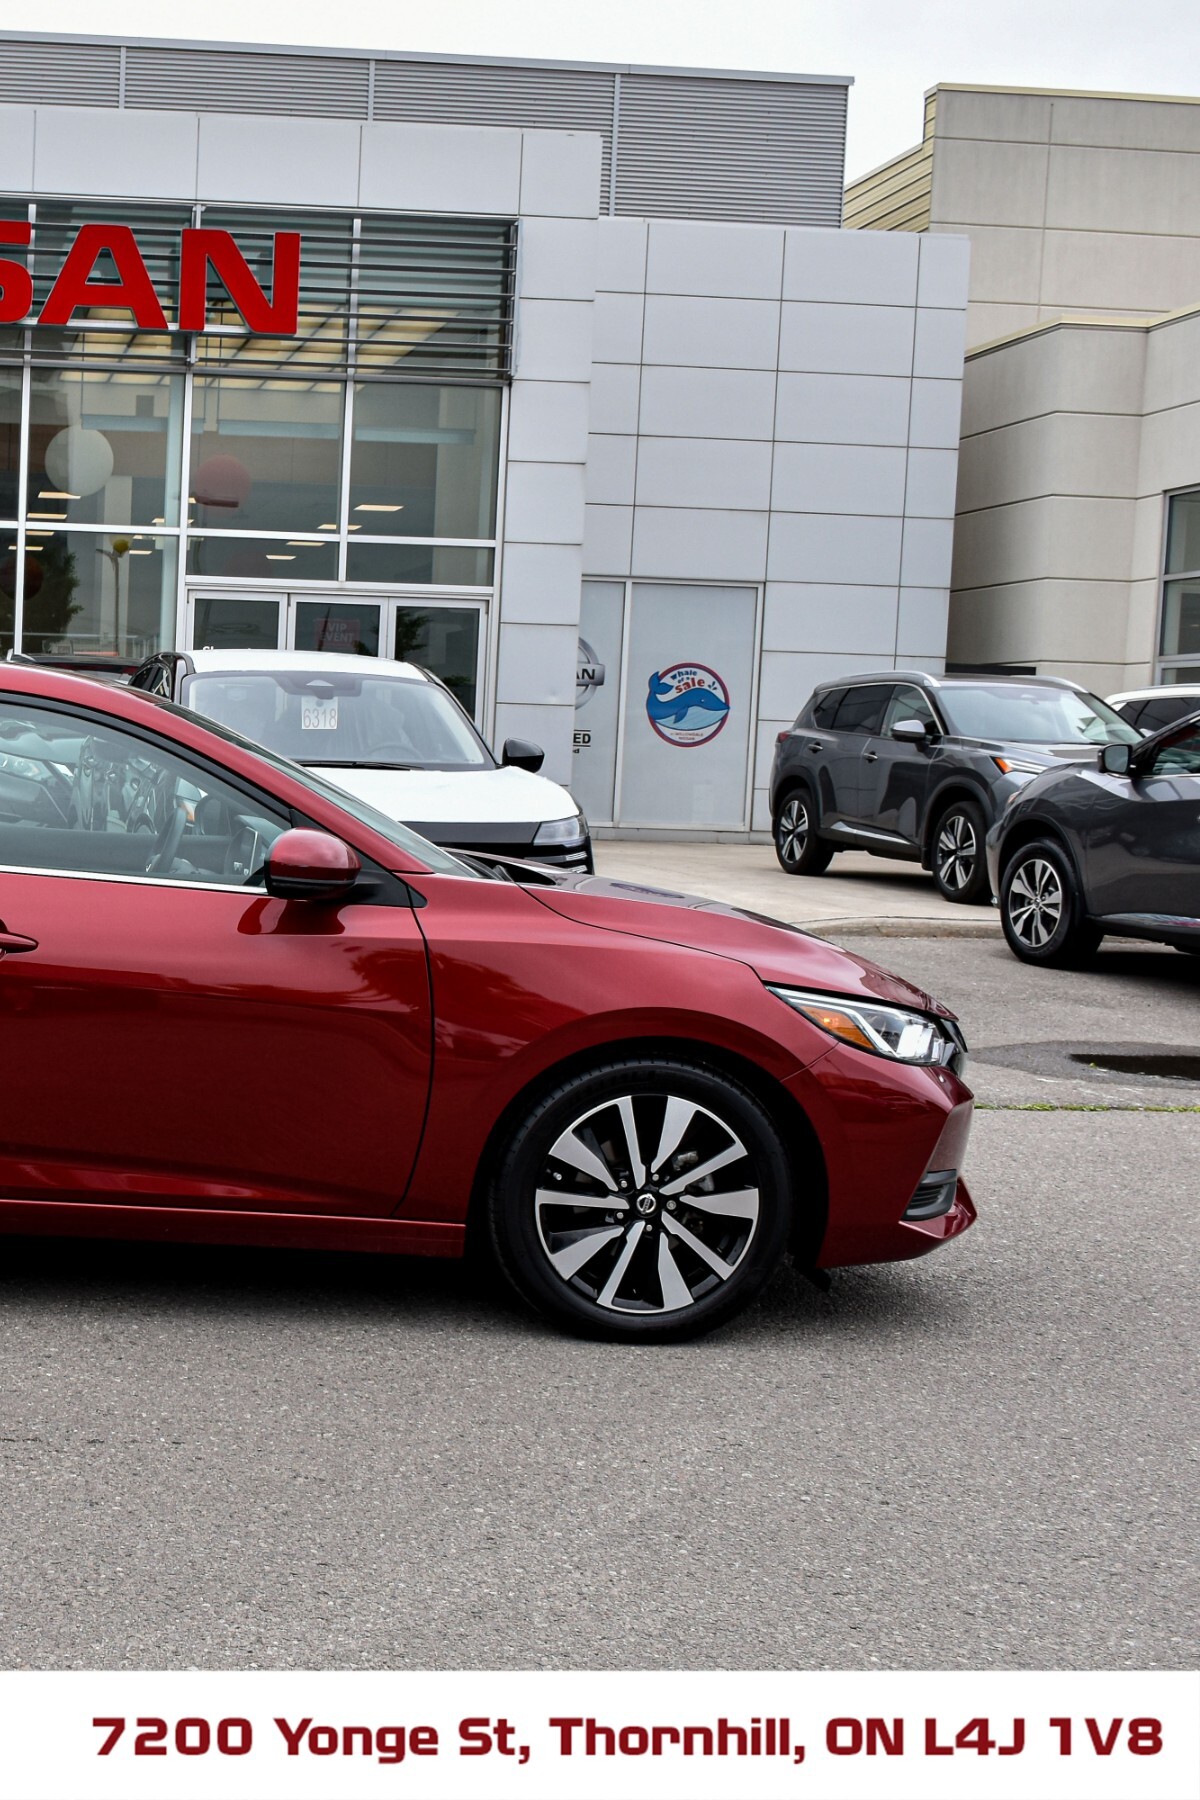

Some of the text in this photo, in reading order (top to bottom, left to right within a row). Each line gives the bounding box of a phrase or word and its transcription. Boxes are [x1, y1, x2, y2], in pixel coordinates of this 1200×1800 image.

[327, 622, 348, 632] VIP
[675, 677, 705, 693] sale
[303, 708, 337, 729] 6318
